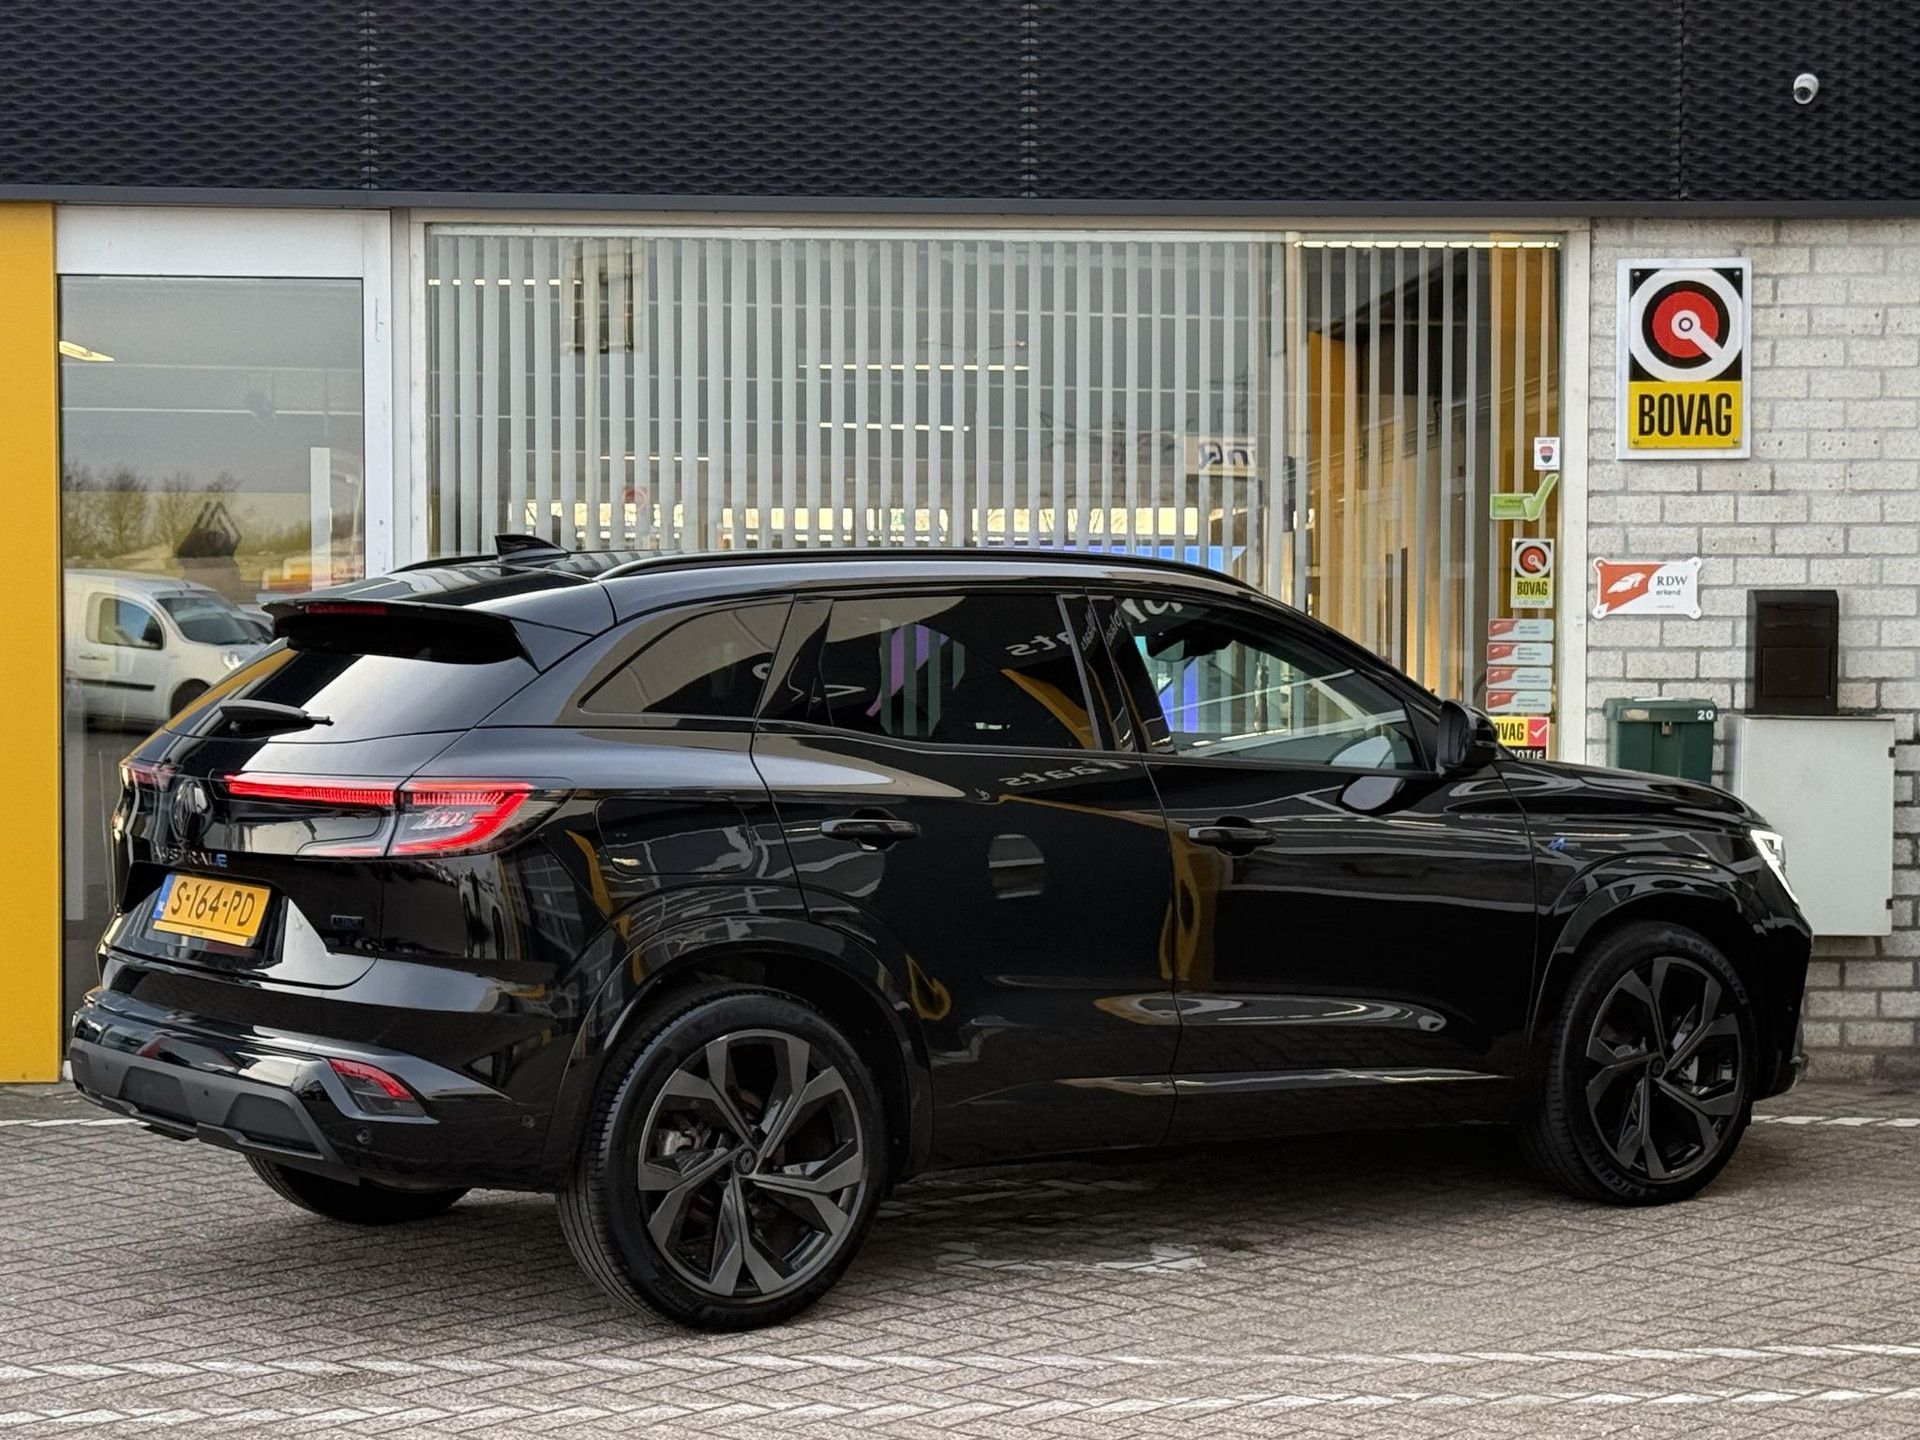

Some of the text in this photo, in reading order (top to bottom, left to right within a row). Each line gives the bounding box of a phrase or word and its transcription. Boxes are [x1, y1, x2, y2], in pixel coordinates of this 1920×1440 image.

[1638, 393, 1733, 437] BOVAG
[1516, 581, 1548, 596] BOVAG
[1656, 576, 1688, 586] RDW
[1697, 709, 1714, 721] 20
[1493, 722, 1525, 741] OVAG
[170, 880, 256, 928] S-164-PD
